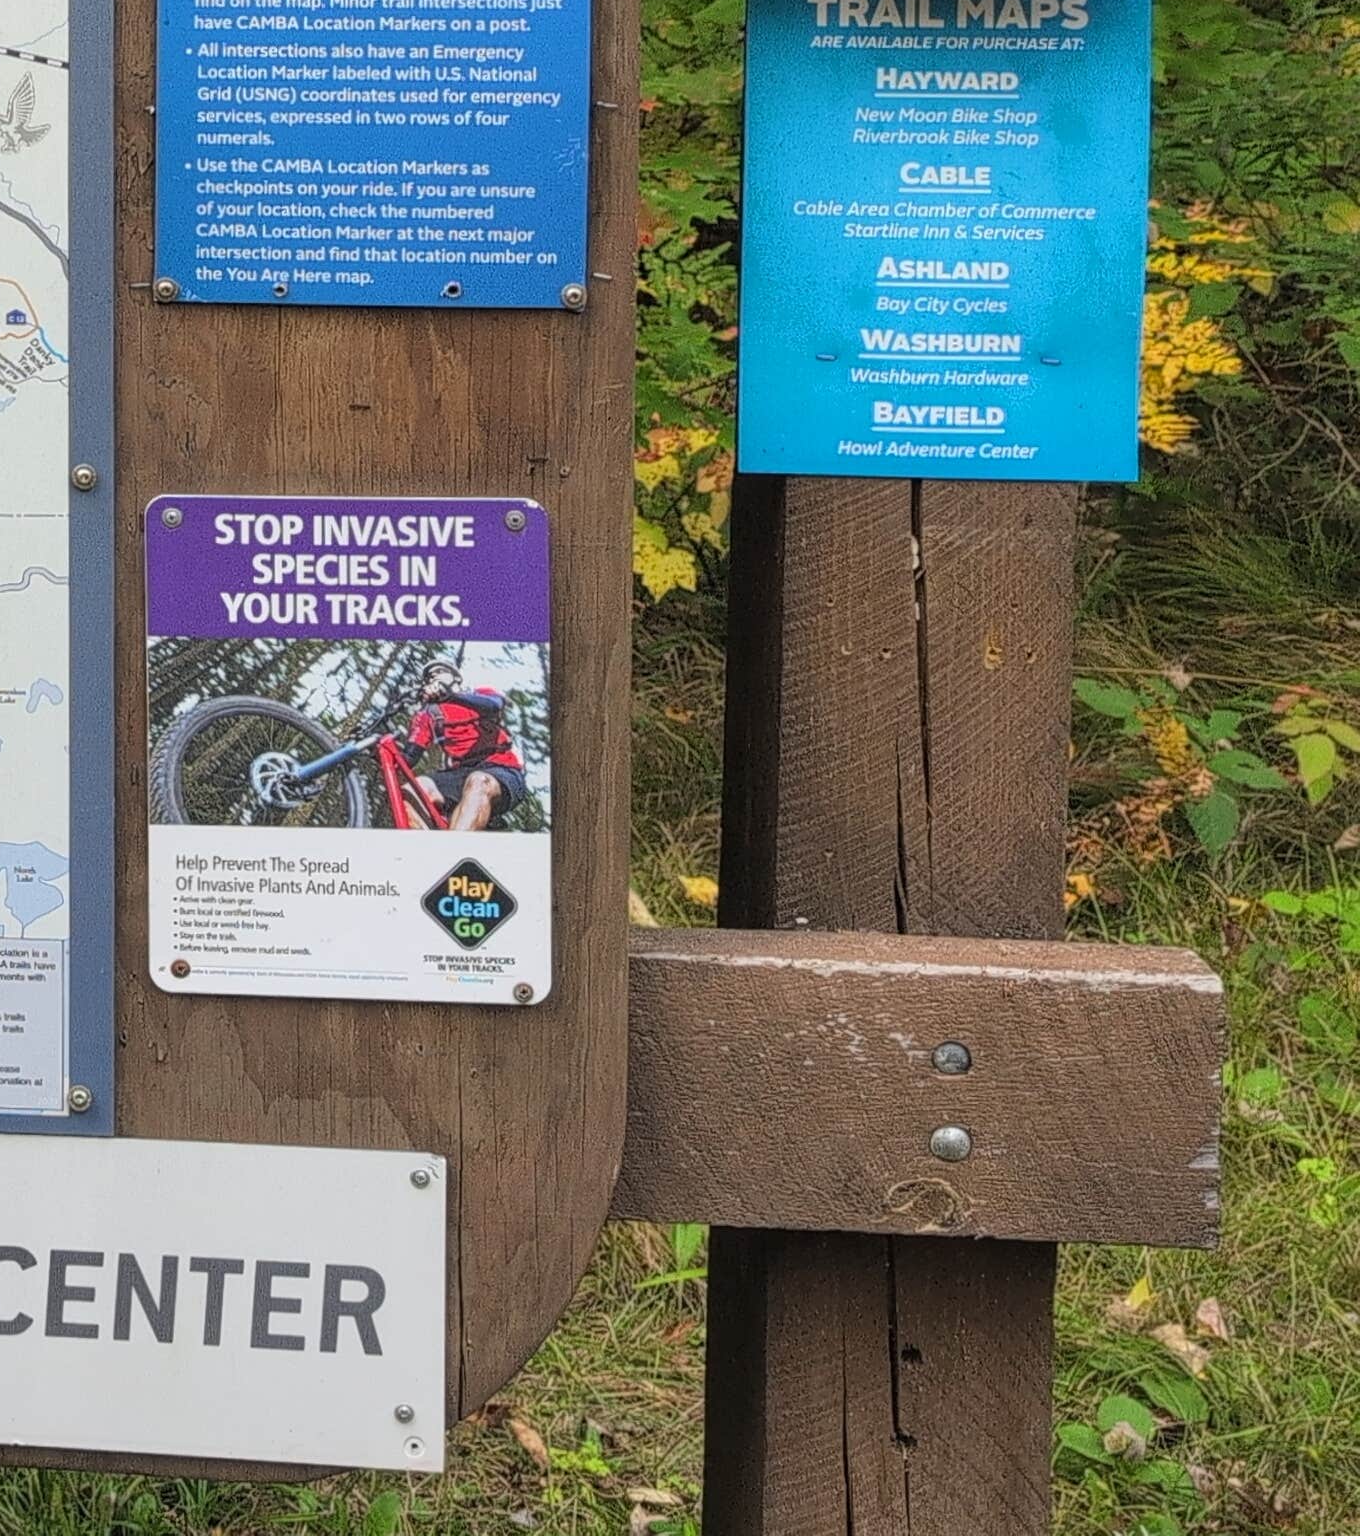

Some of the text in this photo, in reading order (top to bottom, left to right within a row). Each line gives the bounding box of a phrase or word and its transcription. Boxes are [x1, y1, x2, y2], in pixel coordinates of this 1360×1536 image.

[877, 68, 1018, 90] HAYWARD
[856, 108, 1037, 126] New Moon Bike Shop
[853, 128, 1039, 148] Riverbrook Bike Shop
[901, 162, 990, 185] CABLE
[794, 200, 1095, 219] Cable Area Chamber of Commerce
[845, 223, 1043, 240] Startline Inn & Services
[878, 257, 1009, 280] ASHLAND
[877, 296, 1007, 315] Bay City Cycles
[861, 329, 1020, 353] WASHBURN
[851, 368, 1028, 386] Washburn Hardware
[874, 401, 1004, 426] BAYFIELD
[839, 441, 1038, 459] Howl Adventure Center
[215, 514, 474, 547] STOP INVASIVE
[253, 553, 436, 586] SPECIES IN
[221, 592, 469, 626] YOUR TRACKS.
[176, 854, 349, 877] Help Prevent The Spread
[175, 875, 400, 896] Of Invasive Plants And Animals.
[447, 875, 494, 900] Play
[438, 896, 500, 919] Clean
[453, 919, 485, 938] Go
